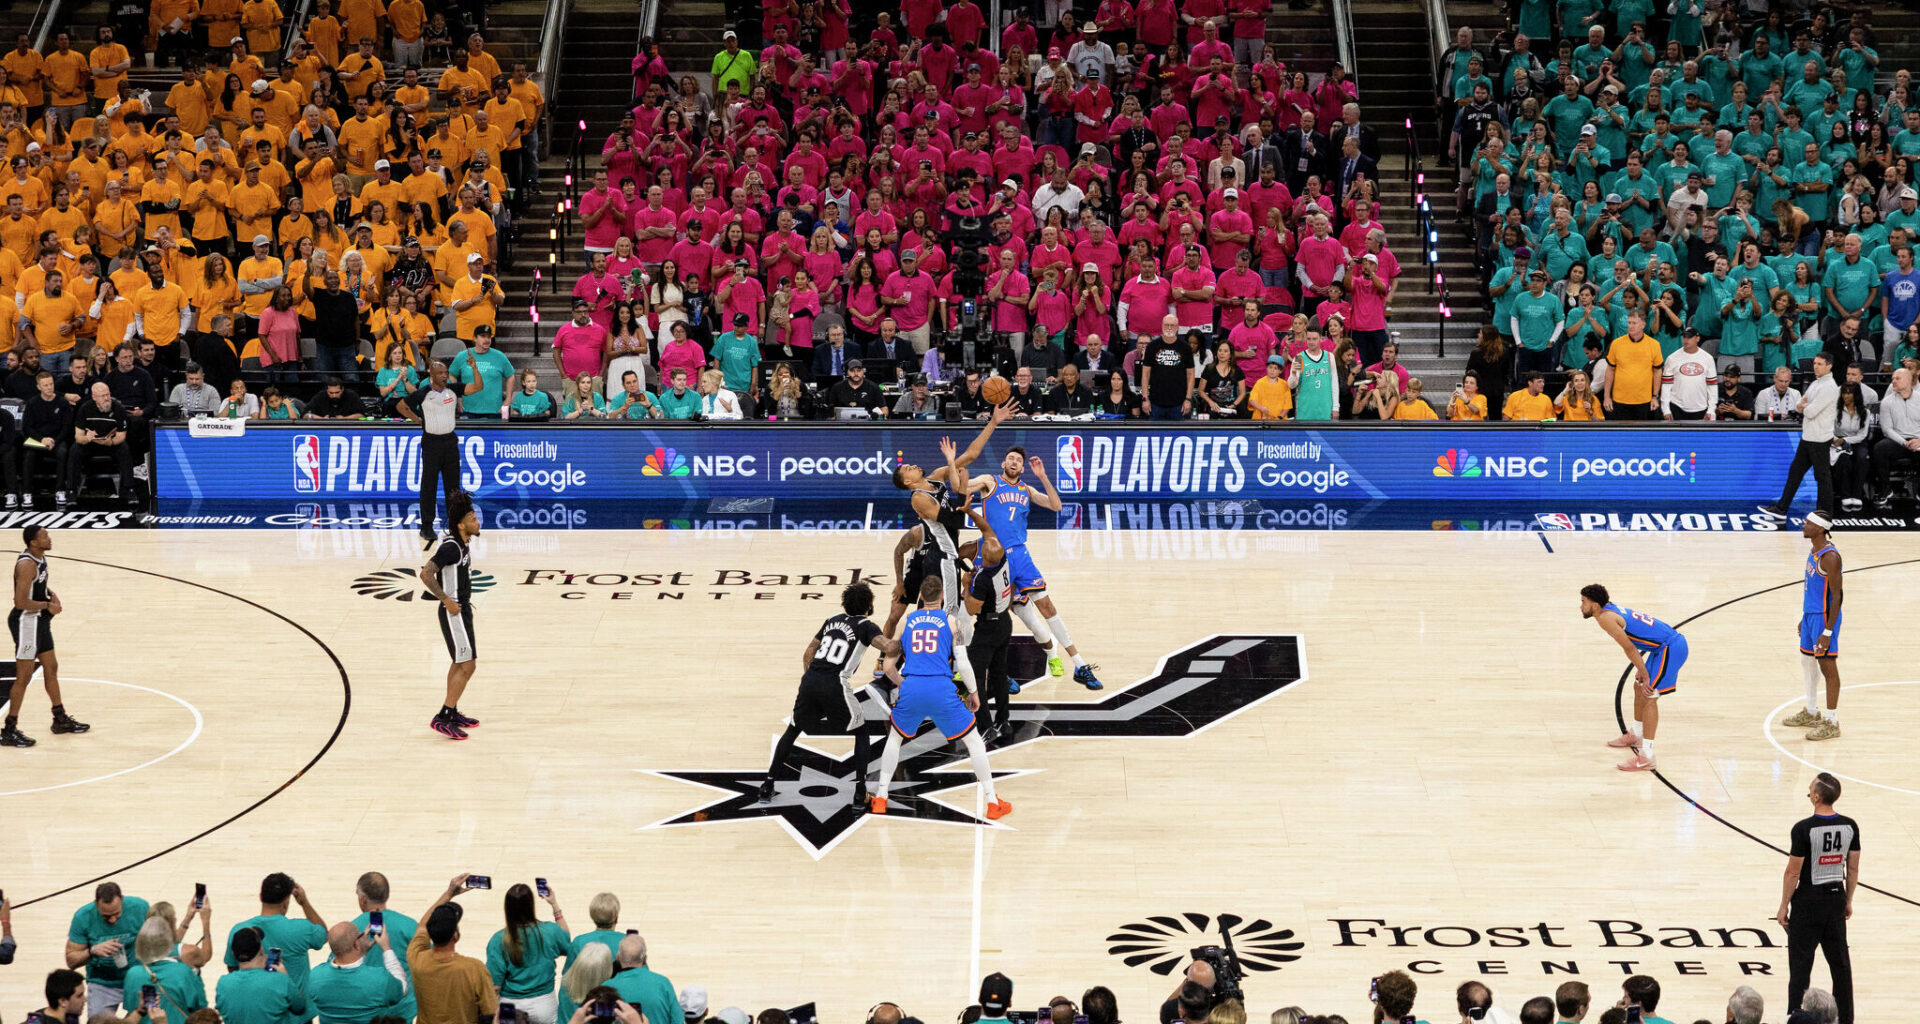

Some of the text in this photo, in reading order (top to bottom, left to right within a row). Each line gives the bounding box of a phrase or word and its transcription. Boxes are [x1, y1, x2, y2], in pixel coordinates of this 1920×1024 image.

[1476, 121, 1482, 131] 1
[1315, 379, 1321, 389] 3
[197, 423, 233, 431] GATORADE
[493, 441, 558, 462] Presented by
[1257, 441, 1322, 462] Presented by
[326, 435, 485, 492] PLAYOS
[693, 455, 757, 477] NBC
[780, 450, 893, 481] peacock
[1088, 435, 1249, 492] PLAYOFFS
[1485, 456, 1549, 478] NBC
[1572, 452, 1686, 483] peacock
[298, 478, 311, 489] NBA
[493, 462, 586, 493] Google
[1060, 479, 1074, 490] NBA
[1256, 462, 1350, 494] Google
[996, 491, 1029, 507] THUNDER
[141, 515, 256, 526] Presented by
[1008, 506, 1017, 522] 7
[1580, 513, 1779, 531] PLAYOFFS
[1790, 517, 1907, 528] Pented by
[517, 568, 891, 587] Frost Bank
[560, 592, 824, 600] CENTER
[823, 621, 857, 642] CHAMPAGNIE
[911, 629, 939, 655] 55
[814, 635, 850, 665] 30
[1822, 830, 1842, 853] 64
[1326, 918, 1788, 948] Frost Ban
[1407, 960, 1775, 976] CENTER
